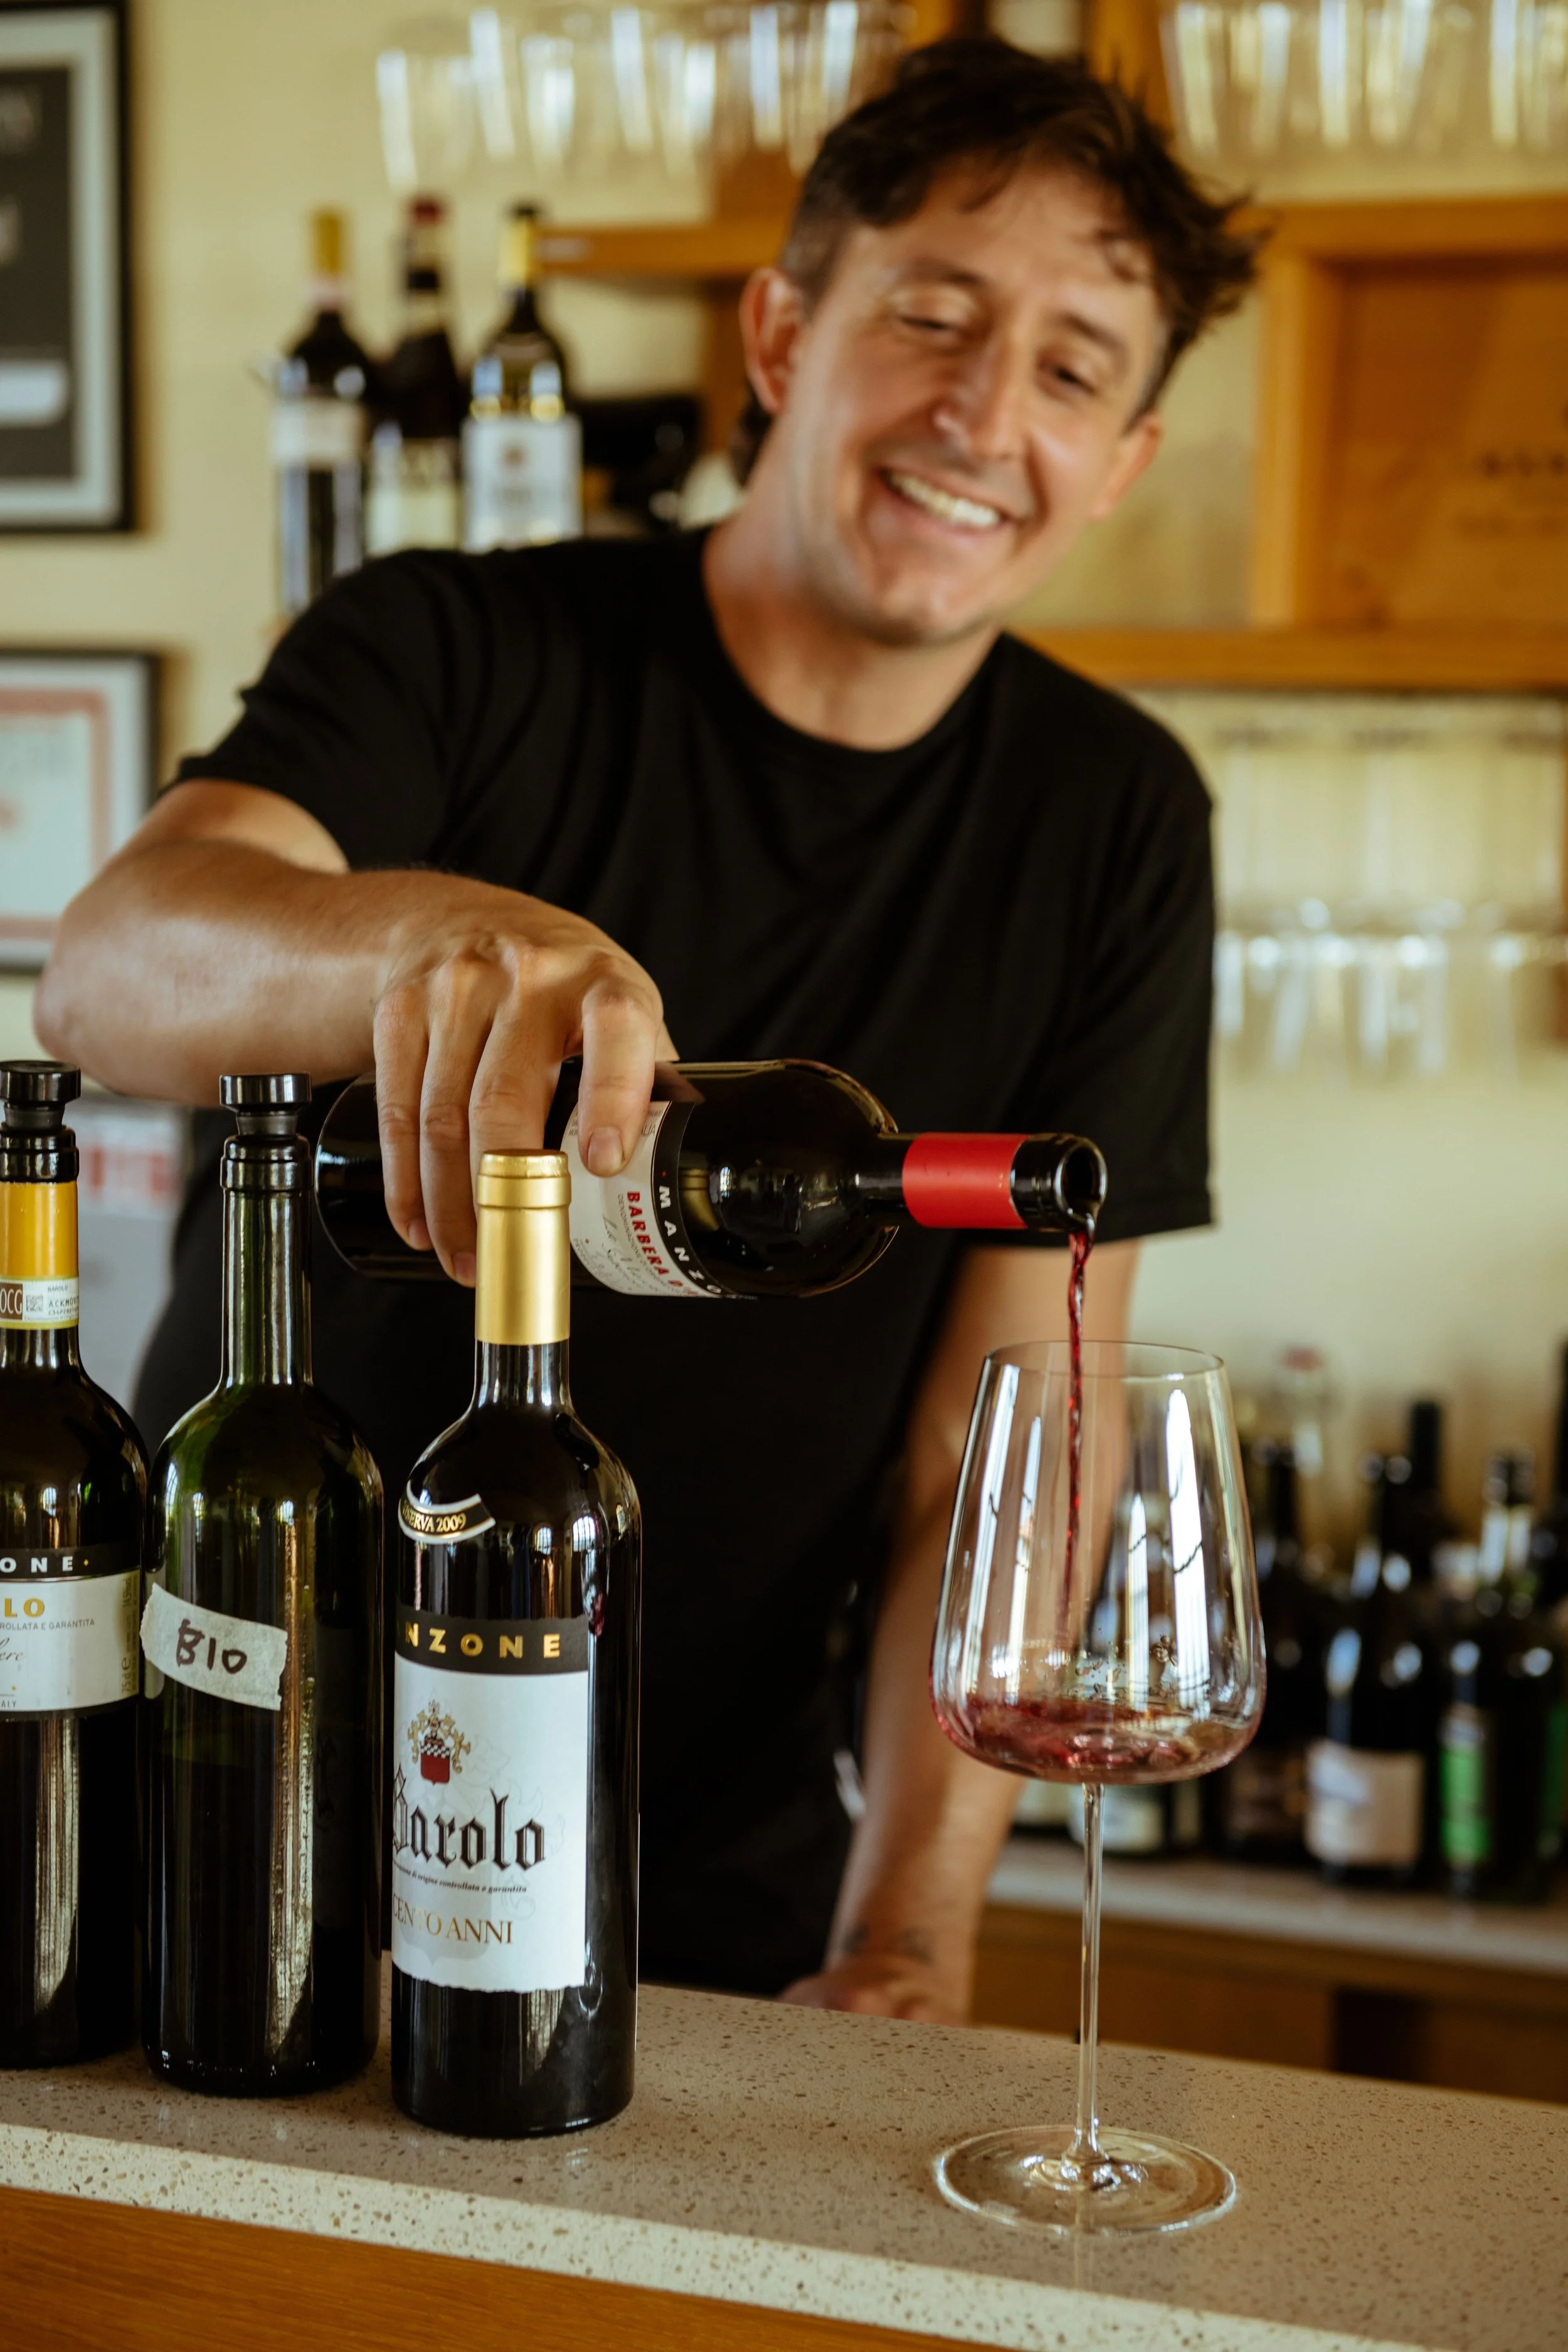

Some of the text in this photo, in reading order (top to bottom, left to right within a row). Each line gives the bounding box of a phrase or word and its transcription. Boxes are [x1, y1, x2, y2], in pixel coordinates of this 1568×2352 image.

[627, 1191, 670, 1275] BARBERA
[436, 1512, 467, 1532] 2009
[41, 1622, 46, 1630] E
[49, 1618, 95, 1630] GARANTITA
[417, 1874, 438, 1885] origine
[439, 1880, 480, 1892] controllata
[487, 1885, 527, 1895] garantita
[393, 1892, 512, 1945] CENTO ANNI
